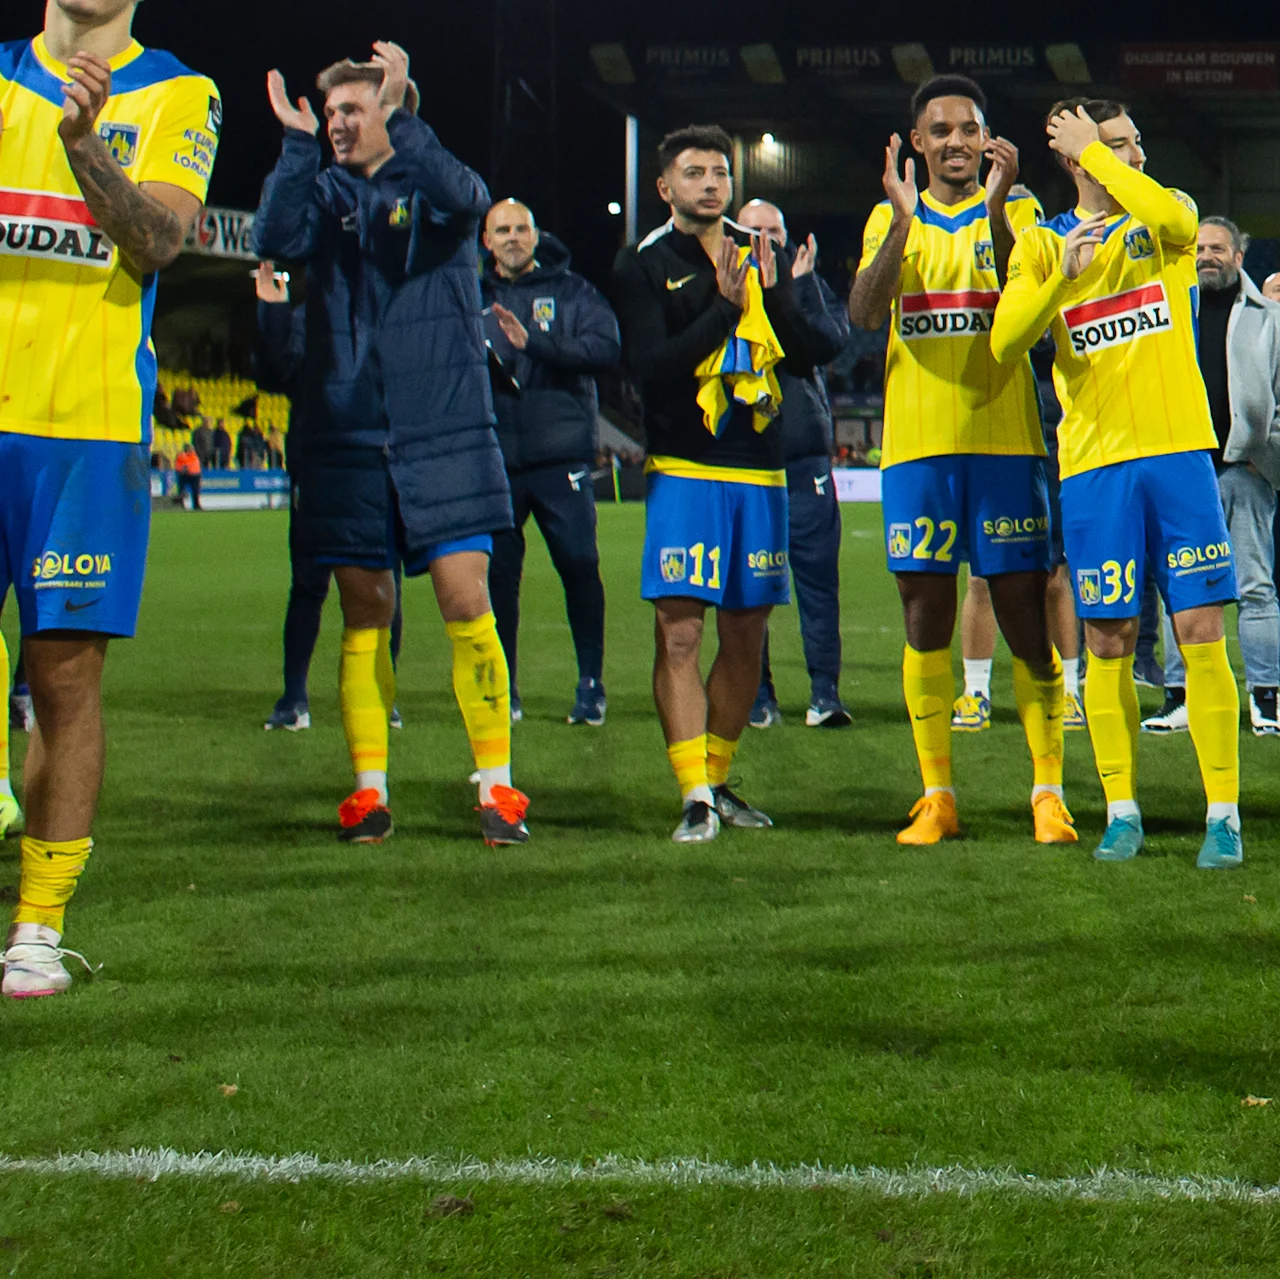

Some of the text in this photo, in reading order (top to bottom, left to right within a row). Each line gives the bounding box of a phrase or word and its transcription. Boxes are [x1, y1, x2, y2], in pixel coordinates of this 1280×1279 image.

[796, 47, 881, 67] PRIMUS
[949, 46, 1035, 66] PRIMUS
[1124, 51, 1276, 65] DUURZAAM BOUWEN
[1166, 70, 1234, 84] IN BETON
[0, 222, 109, 260] UDAL
[901, 312, 992, 336] SOUDA
[1070, 307, 1169, 351] SOUDAL
[912, 517, 957, 562] 22
[688, 542, 720, 589] 11
[1167, 542, 1231, 568] SOLOYA
[1101, 558, 1136, 605] 39
